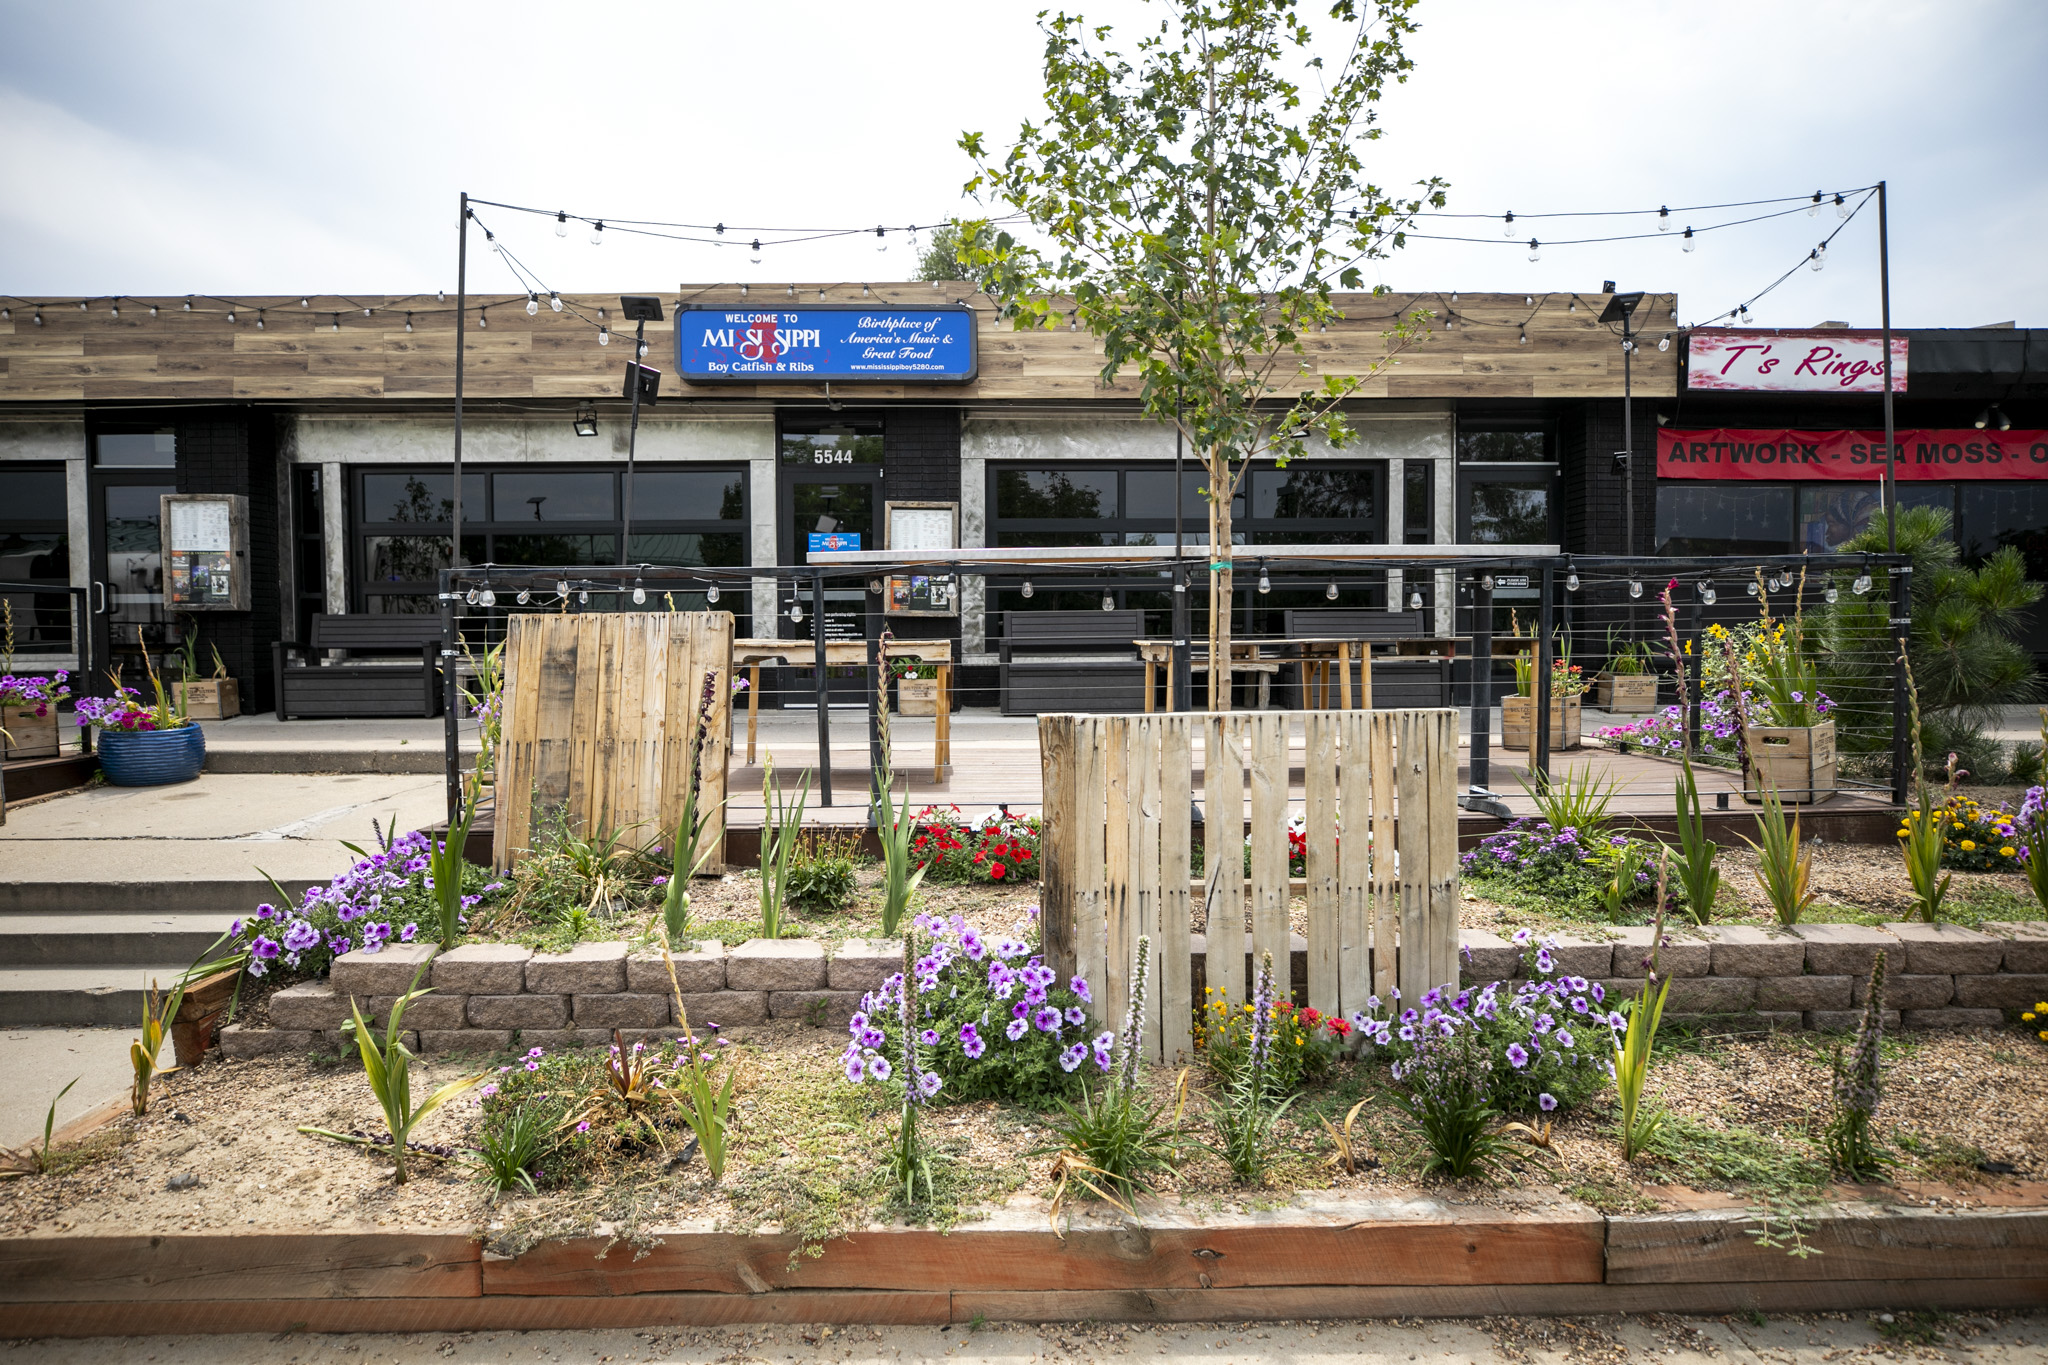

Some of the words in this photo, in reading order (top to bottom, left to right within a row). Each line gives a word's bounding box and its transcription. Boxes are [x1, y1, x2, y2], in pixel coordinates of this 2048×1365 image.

[725, 314, 778, 323] WELCOME
[783, 314, 798, 323] TO
[857, 316, 922, 333] Birthplace
[923, 317, 941, 333] of
[840, 331, 901, 344] America's
[902, 332, 940, 344] Music
[942, 333, 954, 344] &
[862, 346, 896, 359] Great
[898, 346, 935, 359] Food
[708, 362, 729, 373] Boy
[732, 362, 772, 371] Catfish
[776, 362, 786, 371] &
[789, 362, 814, 371] Ribs
[850, 363, 945, 371] www.mississippiboy5280.com
[1720, 344, 1780, 375] T's
[1794, 345, 1892, 386] Rings
[814, 449, 853, 464] 5544
[1668, 442, 1823, 464] ARTWORK
[1916, 443, 2003, 464] MOSS
